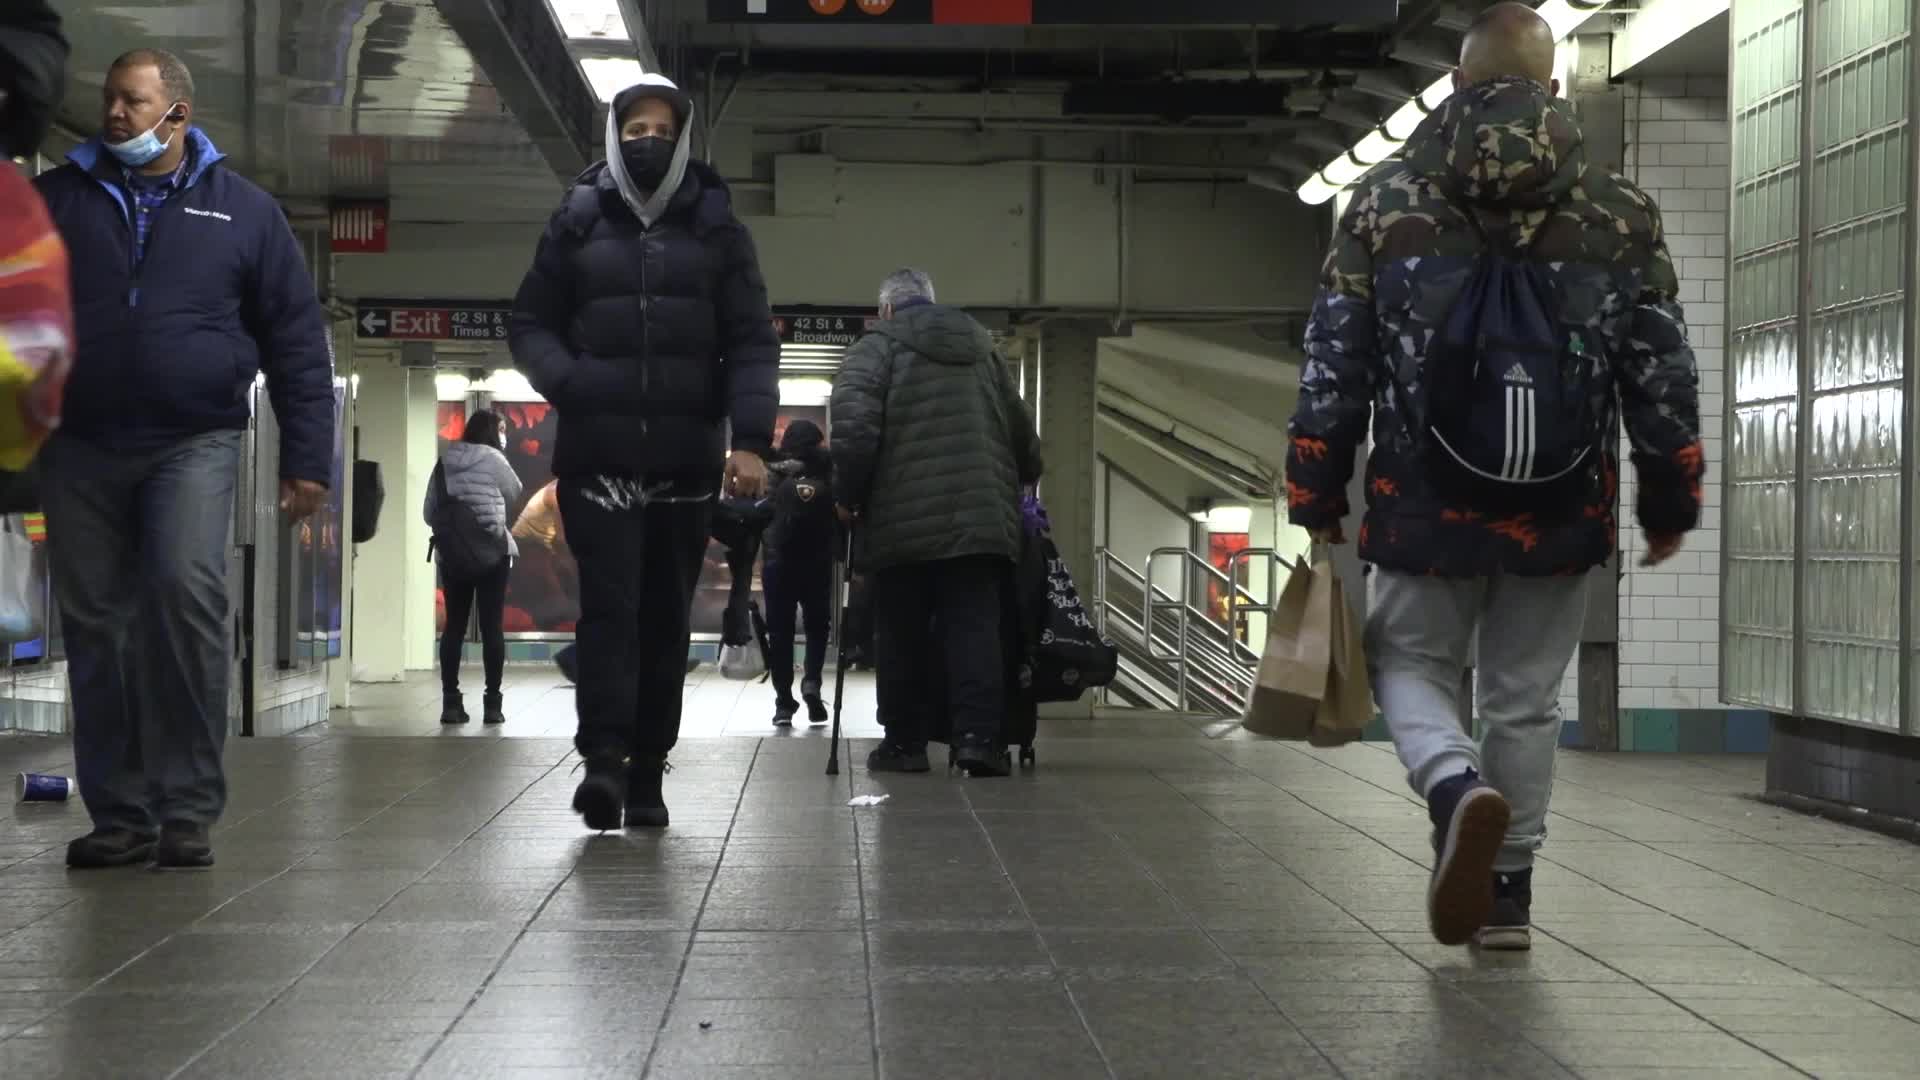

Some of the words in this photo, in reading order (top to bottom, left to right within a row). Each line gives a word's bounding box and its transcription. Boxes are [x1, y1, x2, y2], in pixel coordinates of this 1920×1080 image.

[390, 311, 441, 334] Exit
[451, 312, 467, 324] 42
[472, 312, 487, 325] St
[493, 312, 503, 324] &
[793, 318, 811, 330] 42
[816, 318, 829, 330] St
[835, 318, 845, 330] &
[452, 325, 490, 337] Times
[793, 331, 856, 344] Broadway
